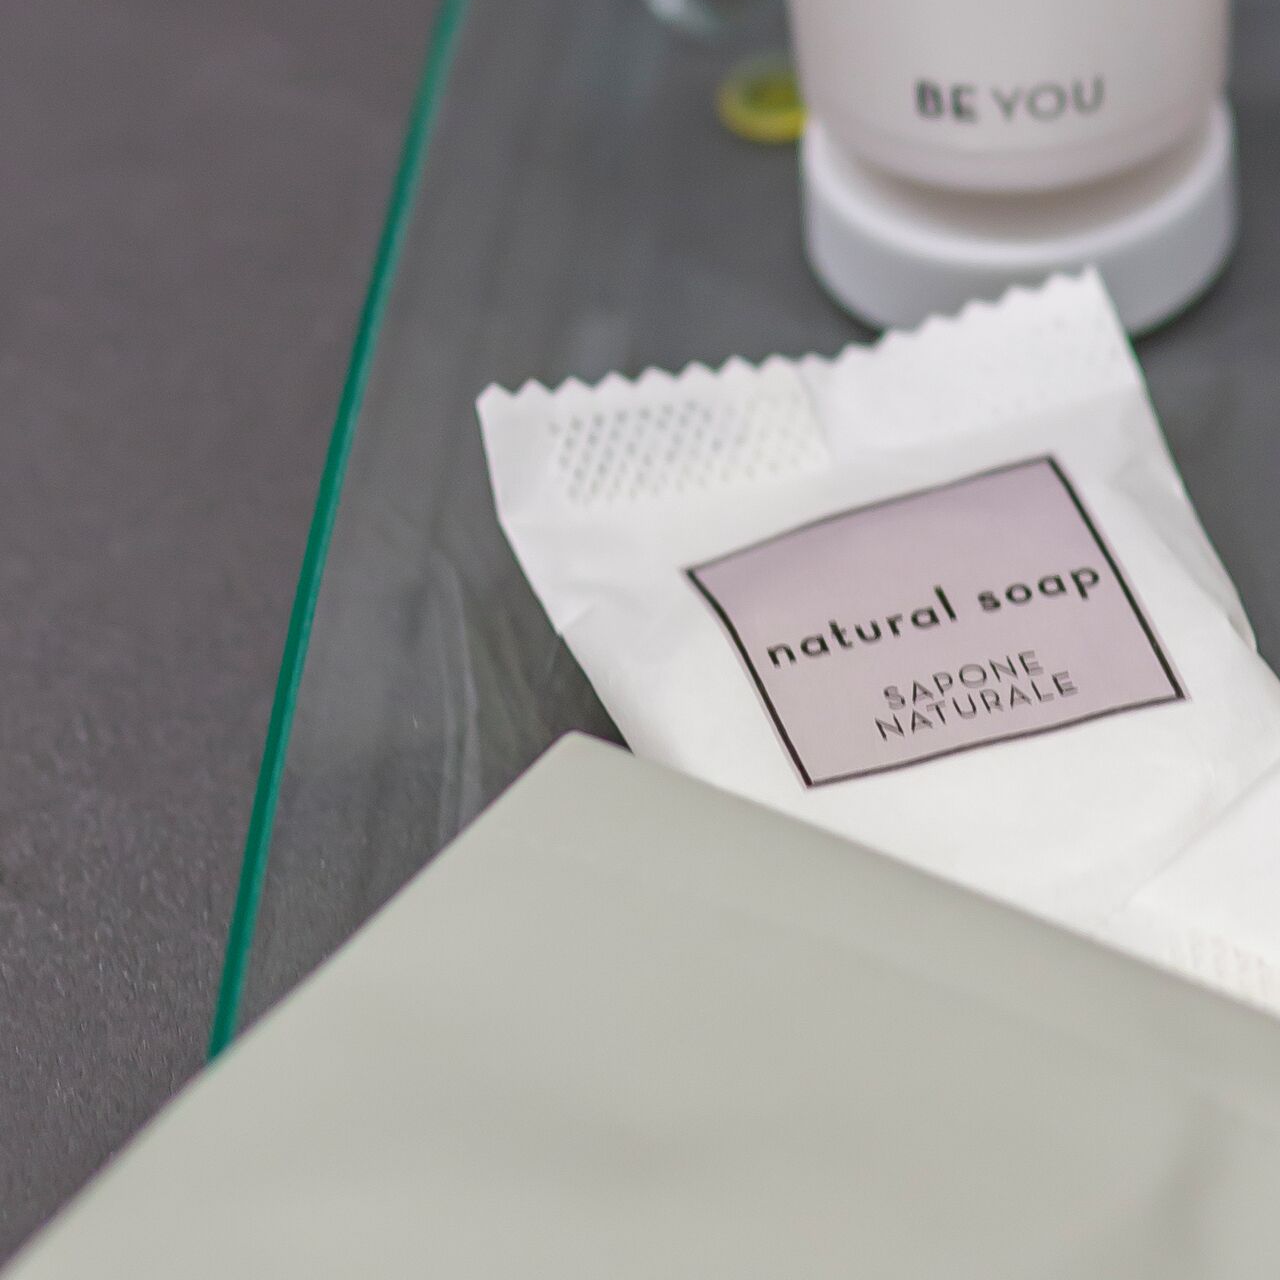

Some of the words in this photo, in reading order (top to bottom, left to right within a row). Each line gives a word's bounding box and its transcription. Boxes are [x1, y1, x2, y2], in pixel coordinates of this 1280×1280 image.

[914, 77, 977, 122] BE
[990, 73, 1105, 122] YOU
[767, 586, 957, 668] natural
[978, 566, 1100, 613] soap
[874, 670, 1078, 741] NATURALE
[883, 650, 1044, 710] SAPONE
